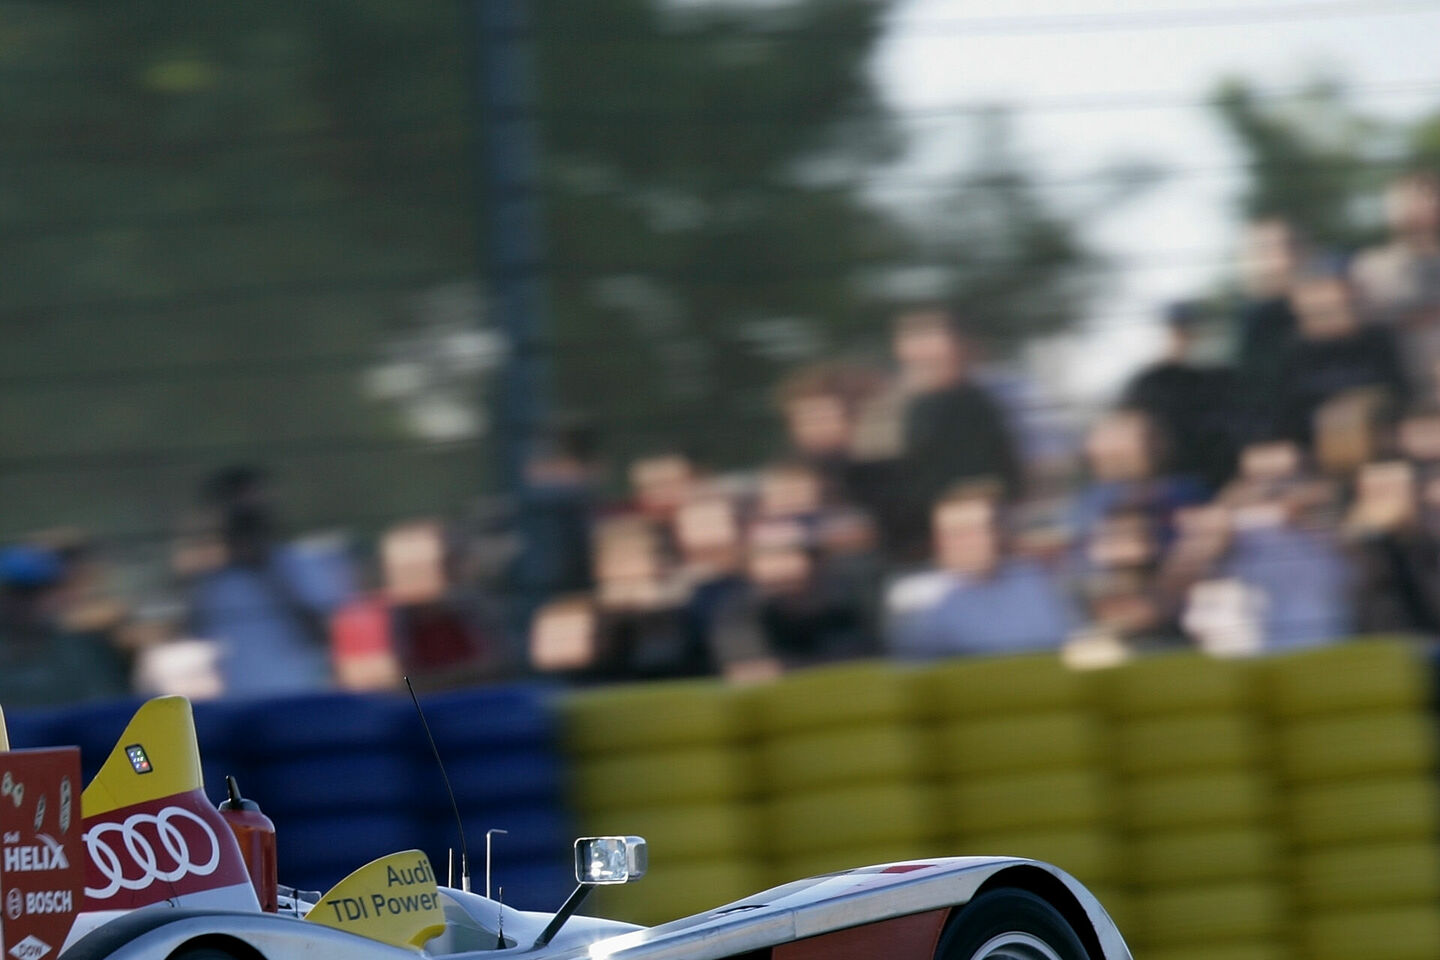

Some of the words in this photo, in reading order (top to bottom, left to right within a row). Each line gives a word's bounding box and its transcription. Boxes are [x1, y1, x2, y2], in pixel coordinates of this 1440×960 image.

[4, 844, 69, 872] HELIX
[387, 859, 434, 887] Audi
[26, 890, 72, 914] BOSCH
[327, 897, 368, 922] TDI
[371, 893, 438, 917] Power
